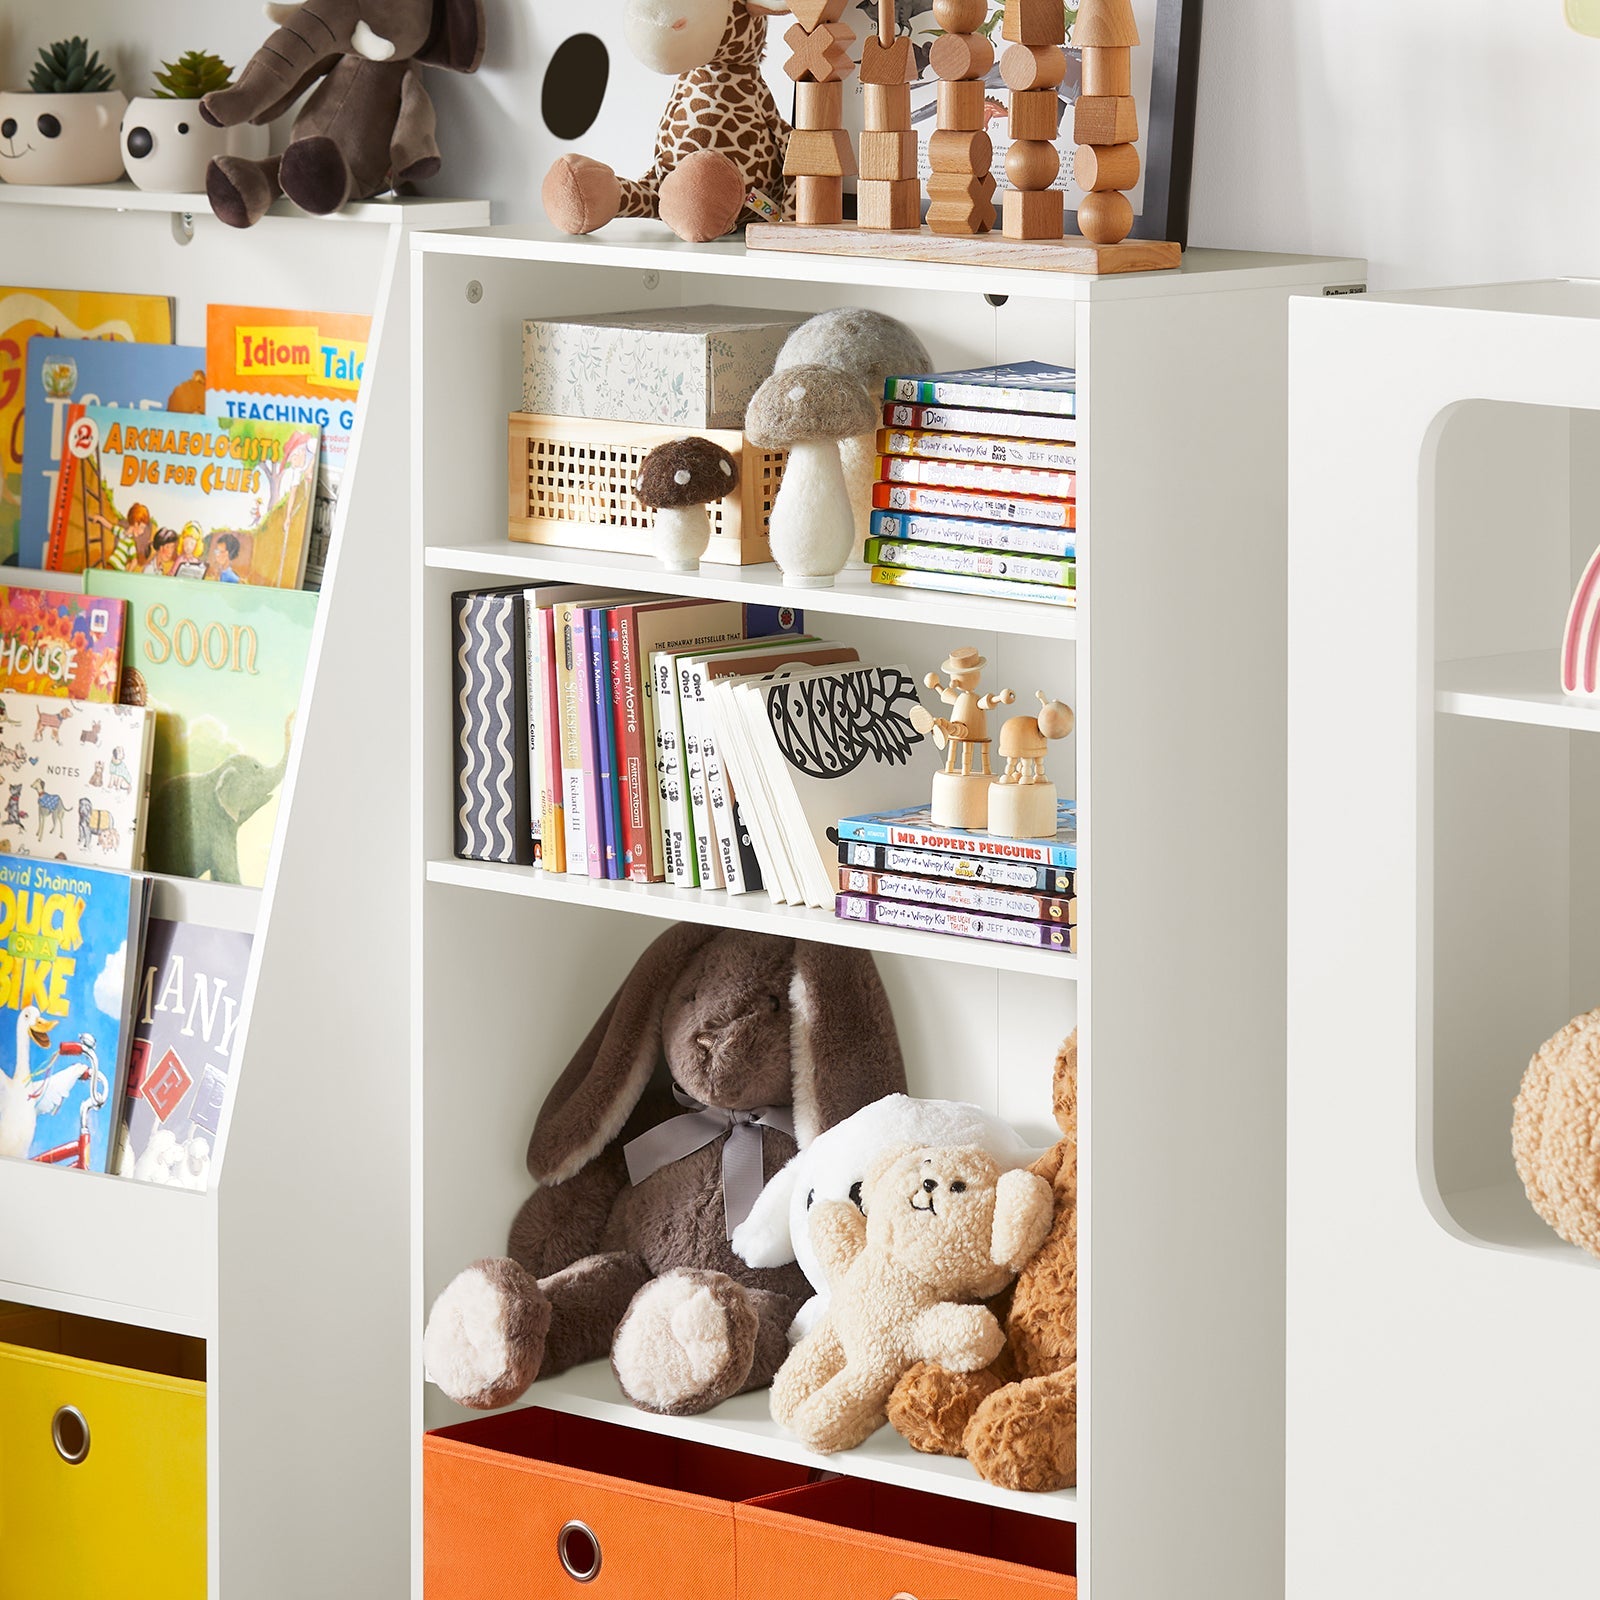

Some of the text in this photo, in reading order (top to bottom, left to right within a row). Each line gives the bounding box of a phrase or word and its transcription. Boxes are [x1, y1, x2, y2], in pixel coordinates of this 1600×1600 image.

[243, 336, 310, 367] Idiom
[226, 401, 329, 429] TEACHING
[75, 424, 93, 449] 2
[103, 422, 280, 463] ARCHAEOLOGISTS
[920, 440, 941, 451] Diary
[953, 444, 976, 457] Wimpy
[976, 445, 987, 455] Kid
[992, 453, 1007, 462] DAYS
[993, 445, 1006, 453] DOG
[1027, 451, 1076, 464] JEFF KINNEY
[120, 454, 260, 495] DIG FOR CLUES
[950, 500, 972, 513] Wimpy
[972, 501, 984, 512] Kid
[985, 501, 1007, 511] THE LONG
[1016, 506, 1063, 521] JEFF KINNEY
[942, 528, 964, 541] Wimpy
[1011, 563, 1059, 579] JEFF KINNEY
[667, 638, 693, 648] RUNAWAY
[695, 634, 726, 645] BESTSELLER
[727, 632, 741, 641] THAT
[593, 652, 601, 667] My
[611, 661, 621, 705] My Daddy
[621, 619, 638, 733] tuesdays with Morrie
[564, 681, 579, 762] SHAKESPEARE
[47, 764, 80, 778] NOTES
[630, 762, 641, 824] Mitch Albom
[570, 776, 580, 831] Richard III
[673, 832, 684, 876] Panda
[897, 832, 918, 845] MR.
[921, 834, 975, 851] POPPER'S
[979, 839, 1042, 860] PENGUINS
[698, 836, 710, 880] Panda
[721, 837, 735, 882] Panda
[892, 854, 911, 866] Diary
[922, 859, 943, 872] Wimpy
[943, 861, 955, 871] Kid
[0, 866, 92, 895] avid Shannon
[988, 868, 1034, 881] JEFF KINNEY
[880, 880, 900, 893] Diary
[912, 885, 935, 899] Wimpy
[935, 887, 946, 899] Kid
[986, 897, 1035, 912] JEFF KINNEY
[878, 905, 899, 919] Diary
[911, 910, 934, 925] Wimpy
[934, 912, 946, 924] Kid
[951, 923, 969, 933] TRUTH
[986, 923, 1037, 939] JEFF KINNEY
[15, 937, 52, 956] ON A
